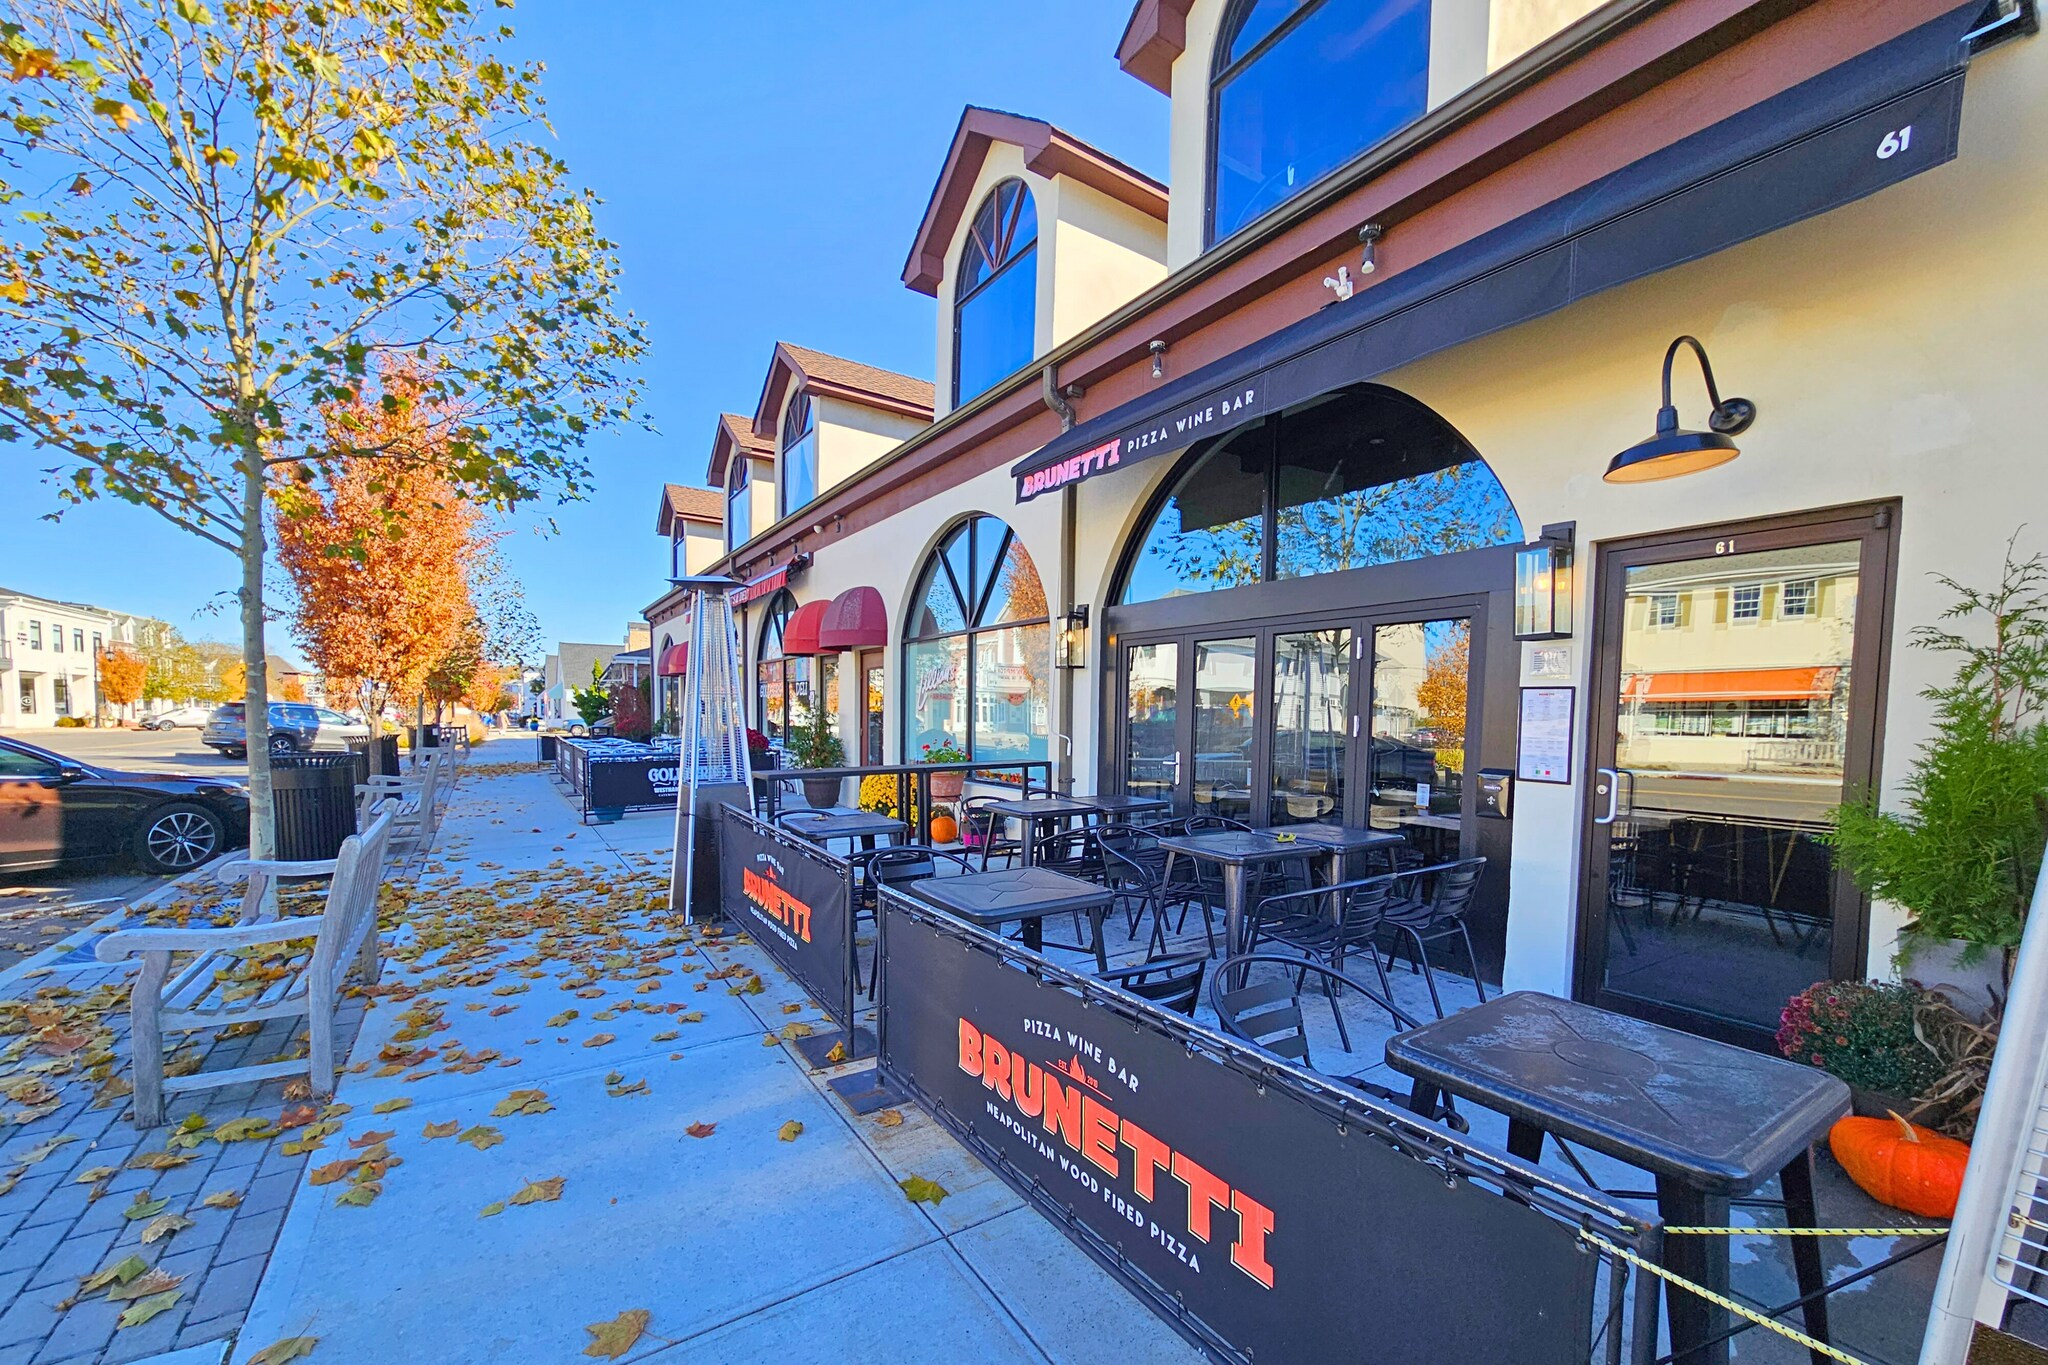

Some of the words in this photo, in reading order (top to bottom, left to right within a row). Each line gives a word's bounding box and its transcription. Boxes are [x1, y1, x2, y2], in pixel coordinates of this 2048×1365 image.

[1876, 125, 1911, 160] 61
[1020, 438, 1121, 498] BRUNETTI
[1127, 427, 1169, 453] PIZZA
[1175, 407, 1214, 433] WINE
[1221, 389, 1255, 416] BAR
[1714, 540, 1736, 555] 61
[743, 866, 812, 944] BRUNETTI
[1023, 1018, 1062, 1042] PIZZA
[1066, 1031, 1103, 1064] WINE
[1107, 1056, 1139, 1093] BAR
[957, 1017, 1276, 1290] BRUNETTI
[985, 1100, 1055, 1163] NEAPOLITAN
[1058, 1154, 1099, 1194] WOOD
[1103, 1187, 1145, 1228] FIRED
[1149, 1221, 1201, 1274] PIZZA
